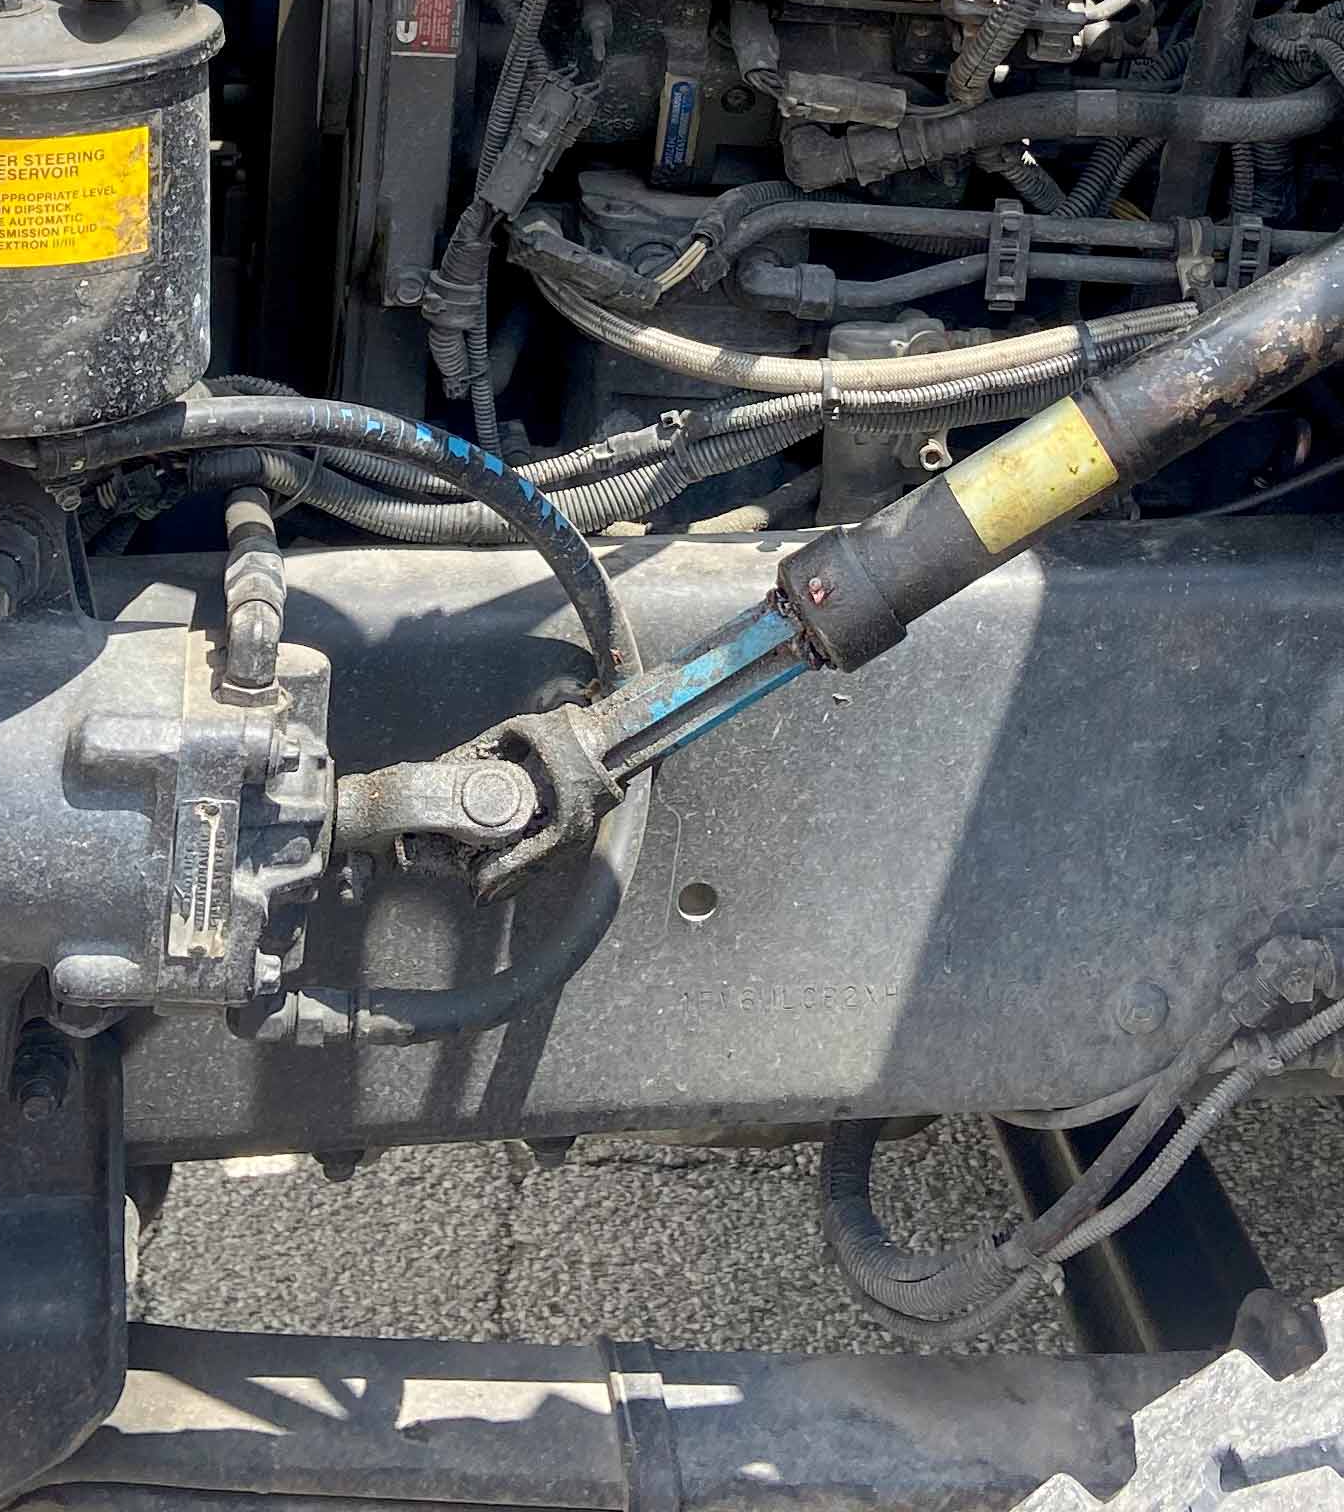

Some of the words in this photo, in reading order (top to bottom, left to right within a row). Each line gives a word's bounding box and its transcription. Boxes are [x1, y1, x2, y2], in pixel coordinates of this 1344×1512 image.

[23, 149, 105, 166] STEERING
[83, 186, 117, 197] LEVEL
[15, 203, 72, 214] DIPSTICK
[9, 214, 82, 226] AUTOMATIC
[63, 224, 97, 234] FLUID
